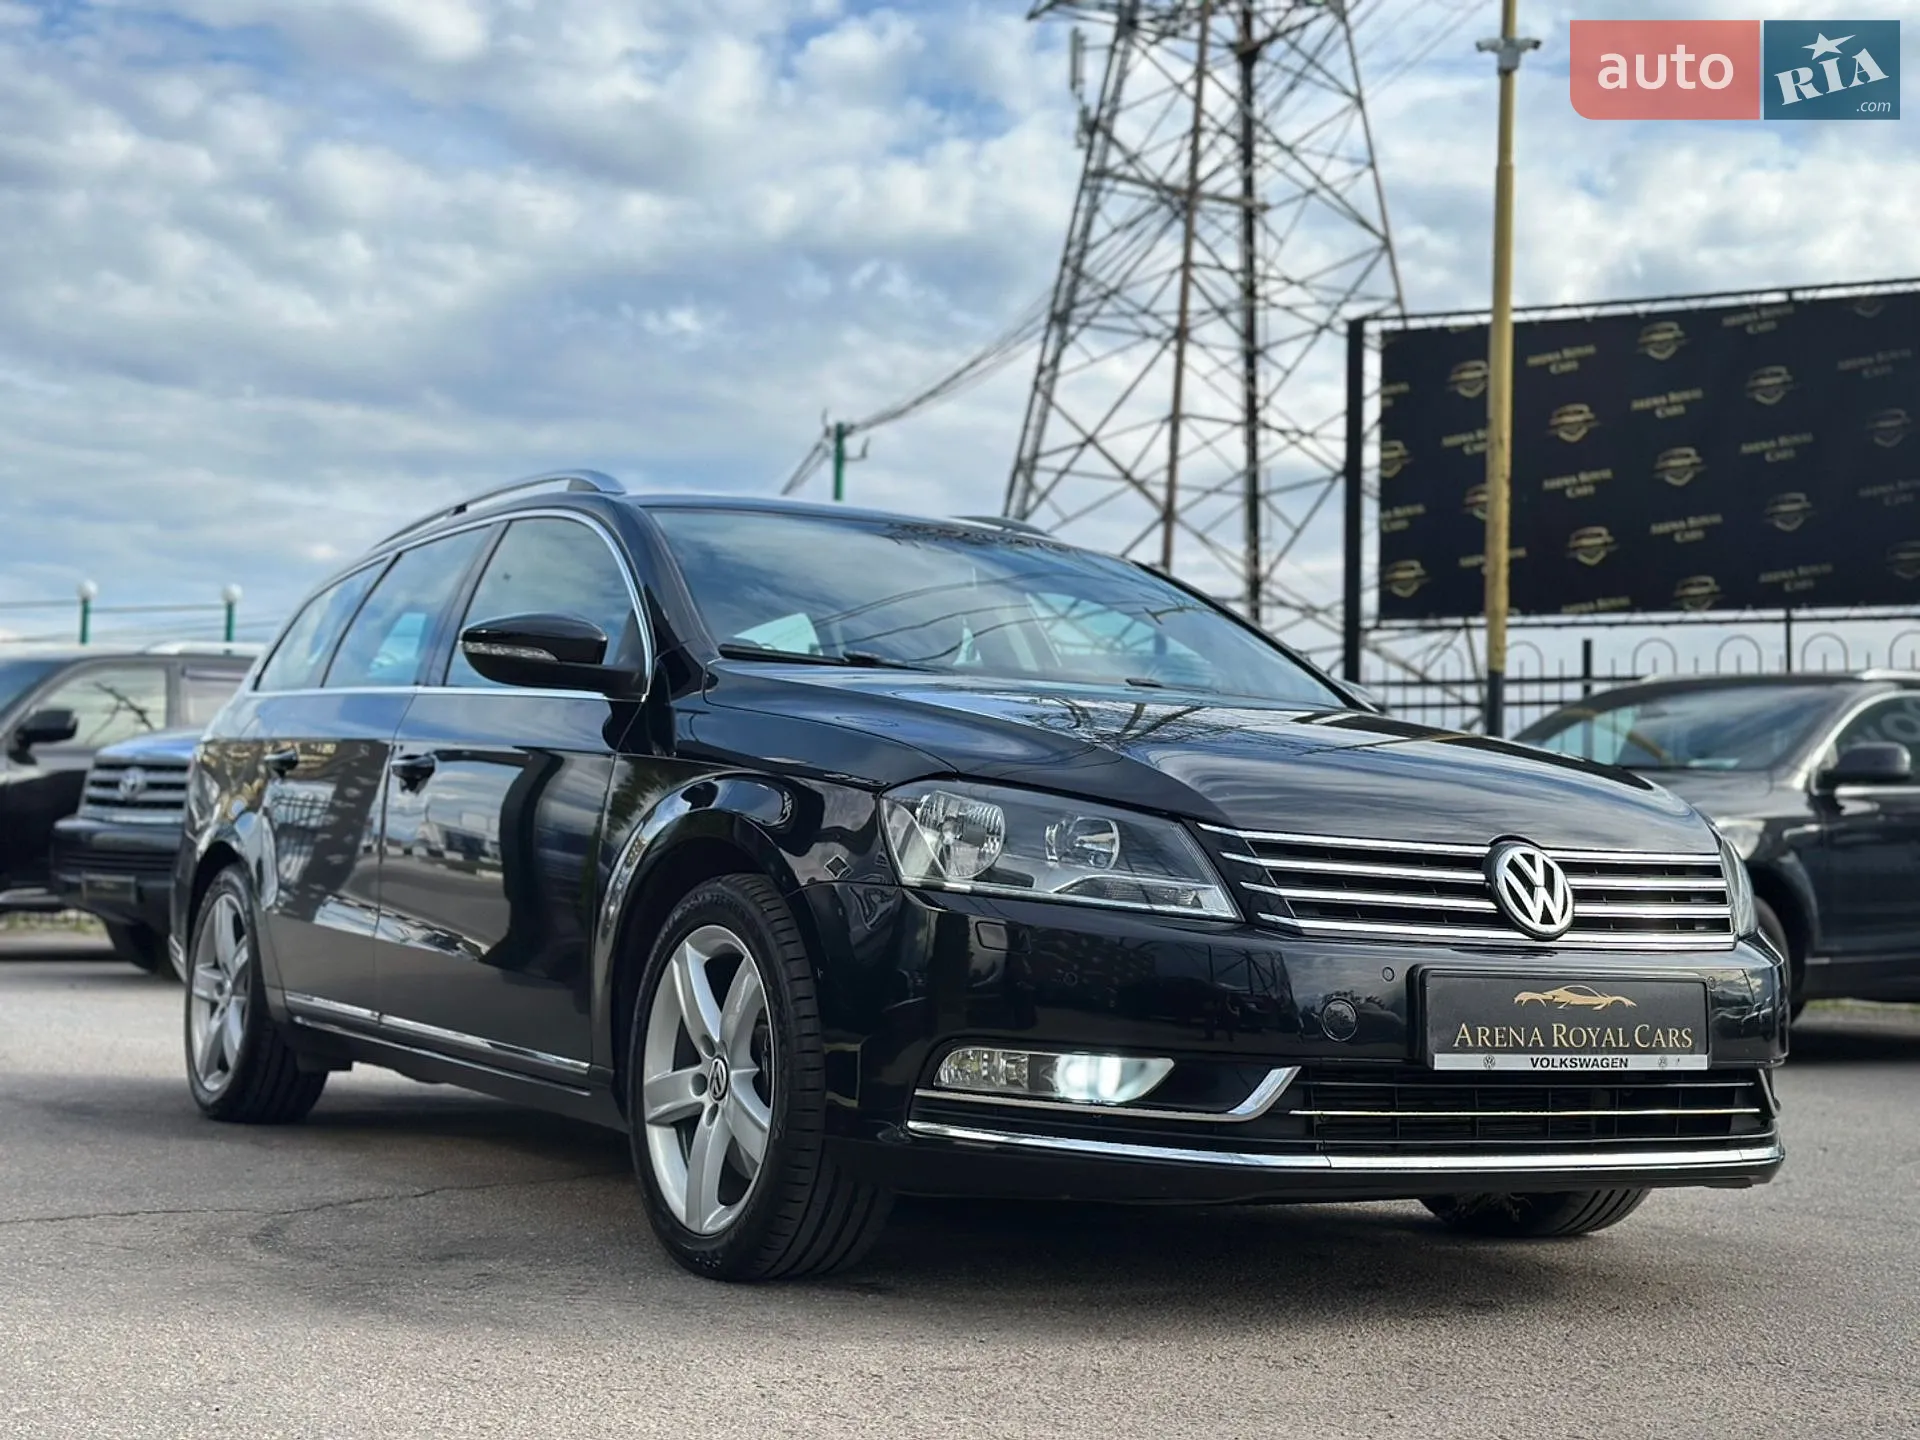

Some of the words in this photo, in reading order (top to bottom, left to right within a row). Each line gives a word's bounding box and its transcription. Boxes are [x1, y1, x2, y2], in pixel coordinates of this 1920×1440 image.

[1452, 1023, 1545, 1048] ARENA
[1551, 1023, 1629, 1048] ROYAL
[1634, 1023, 1693, 1048] CARS
[1530, 1057, 1629, 1069] VOLKSWAGEN
